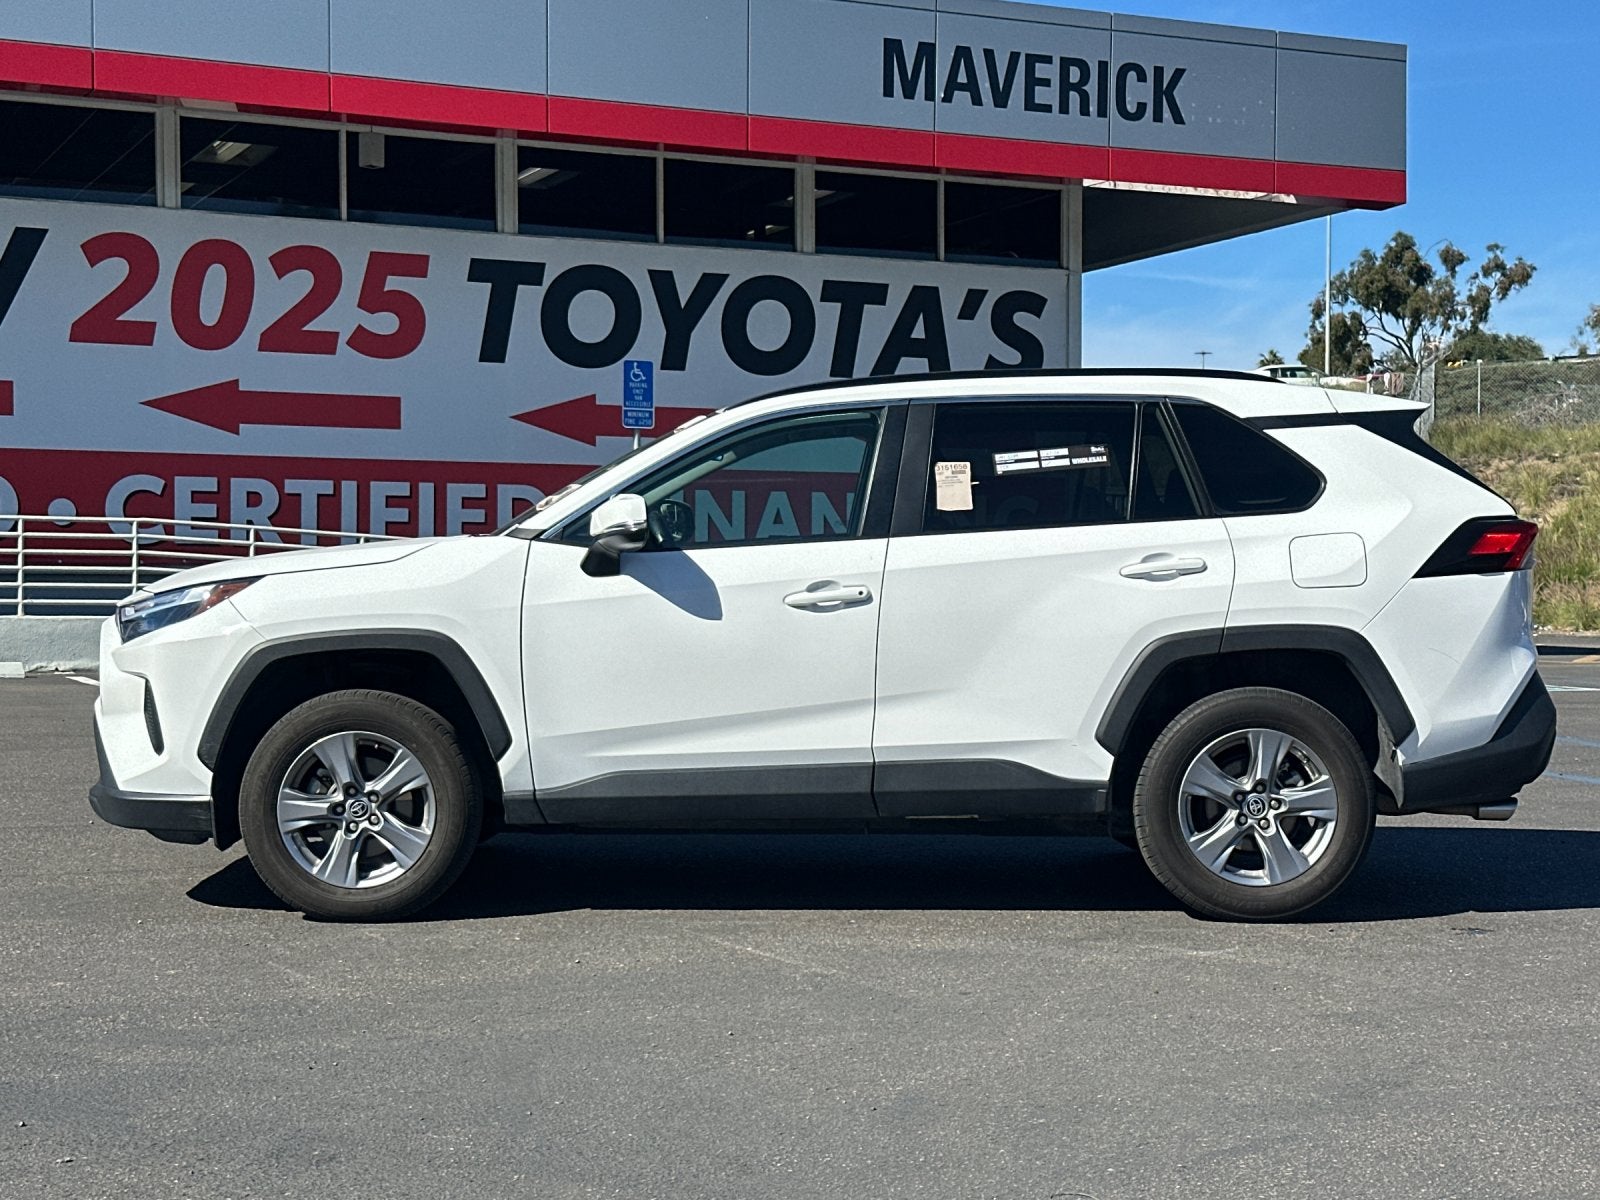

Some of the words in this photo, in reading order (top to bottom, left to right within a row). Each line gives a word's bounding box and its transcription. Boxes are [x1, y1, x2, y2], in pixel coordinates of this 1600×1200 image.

[883, 38, 1187, 126] MAVERICK
[69, 232, 430, 360] 2025
[467, 258, 1049, 379] TOYOTA'S
